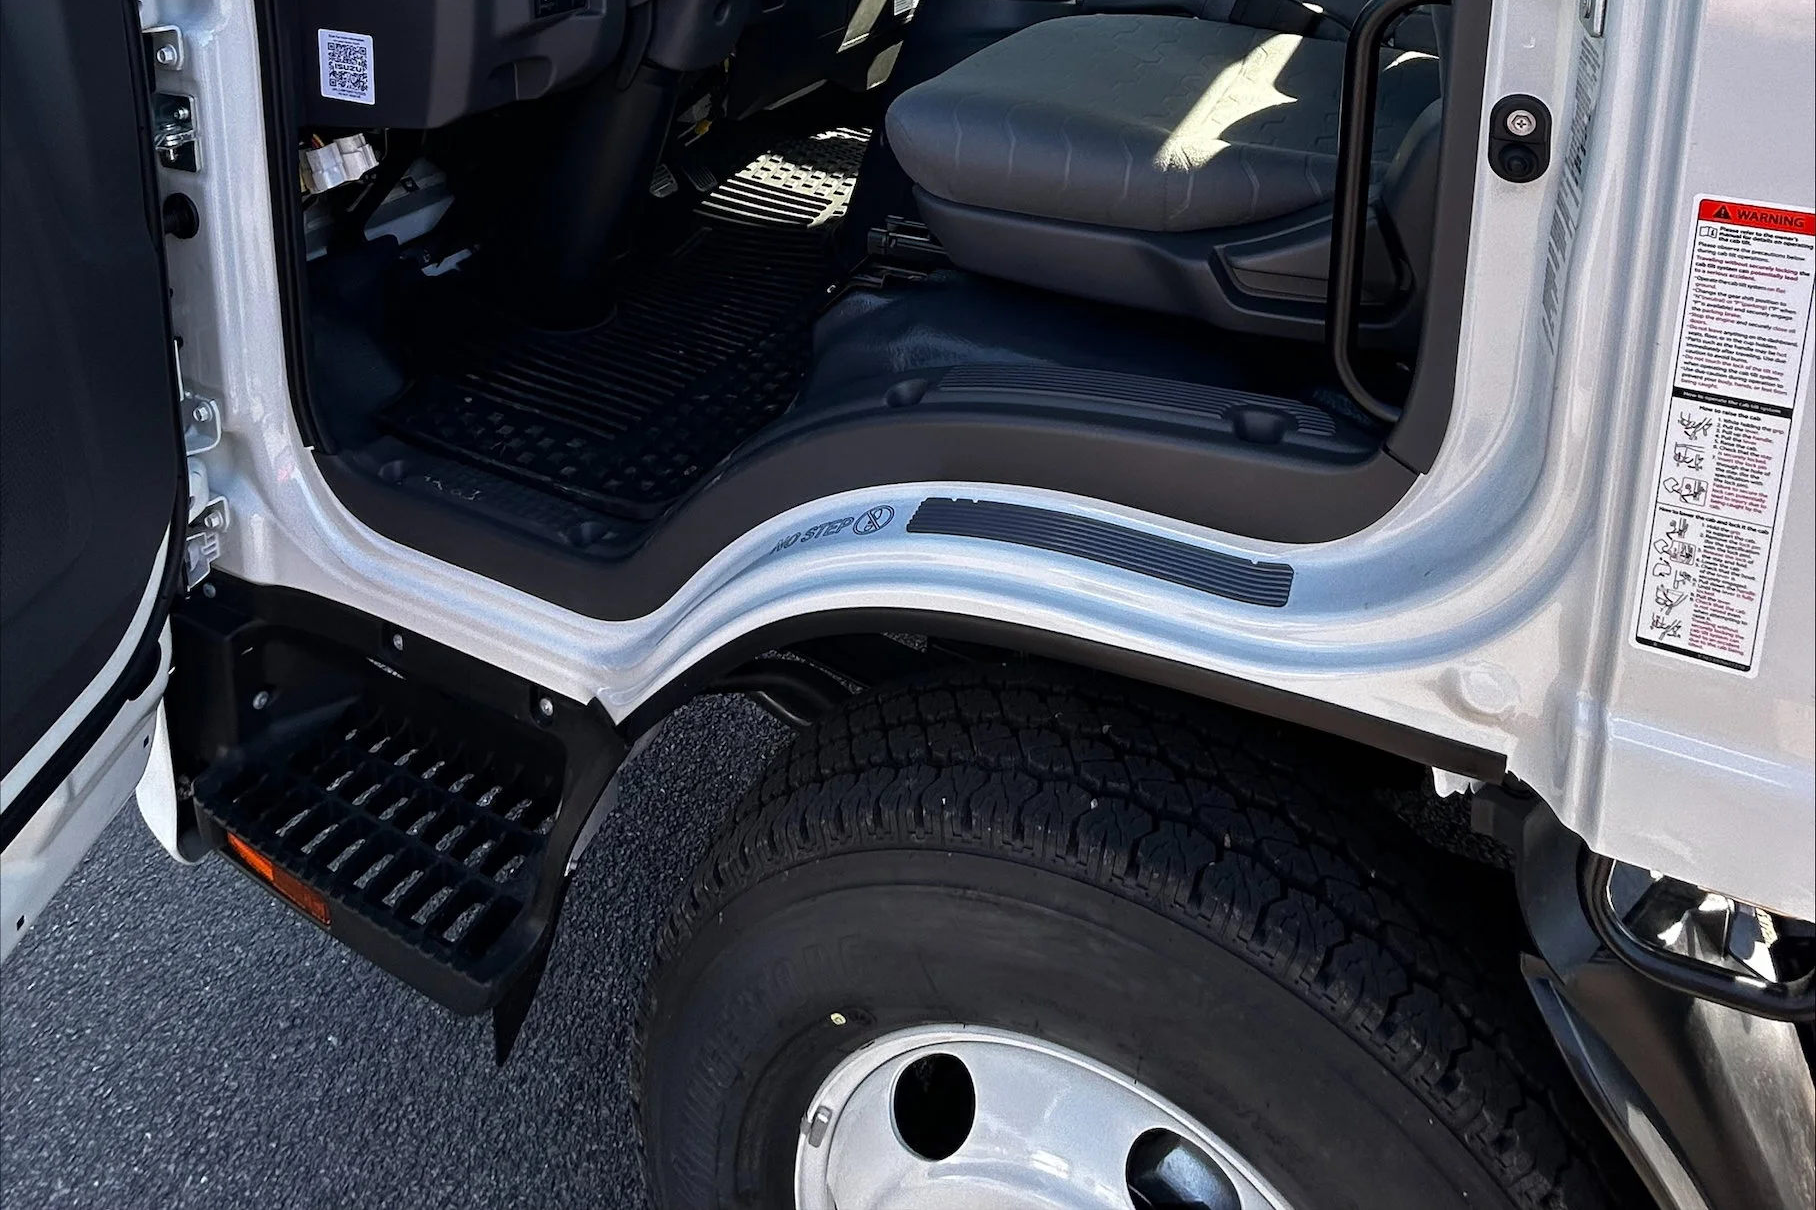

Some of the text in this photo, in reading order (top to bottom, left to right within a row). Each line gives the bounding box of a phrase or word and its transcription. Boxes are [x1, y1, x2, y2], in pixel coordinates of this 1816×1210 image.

[334, 63, 362, 72] ISUZU
[1736, 208, 1804, 227] WARNING
[769, 516, 855, 555] NO STEP
